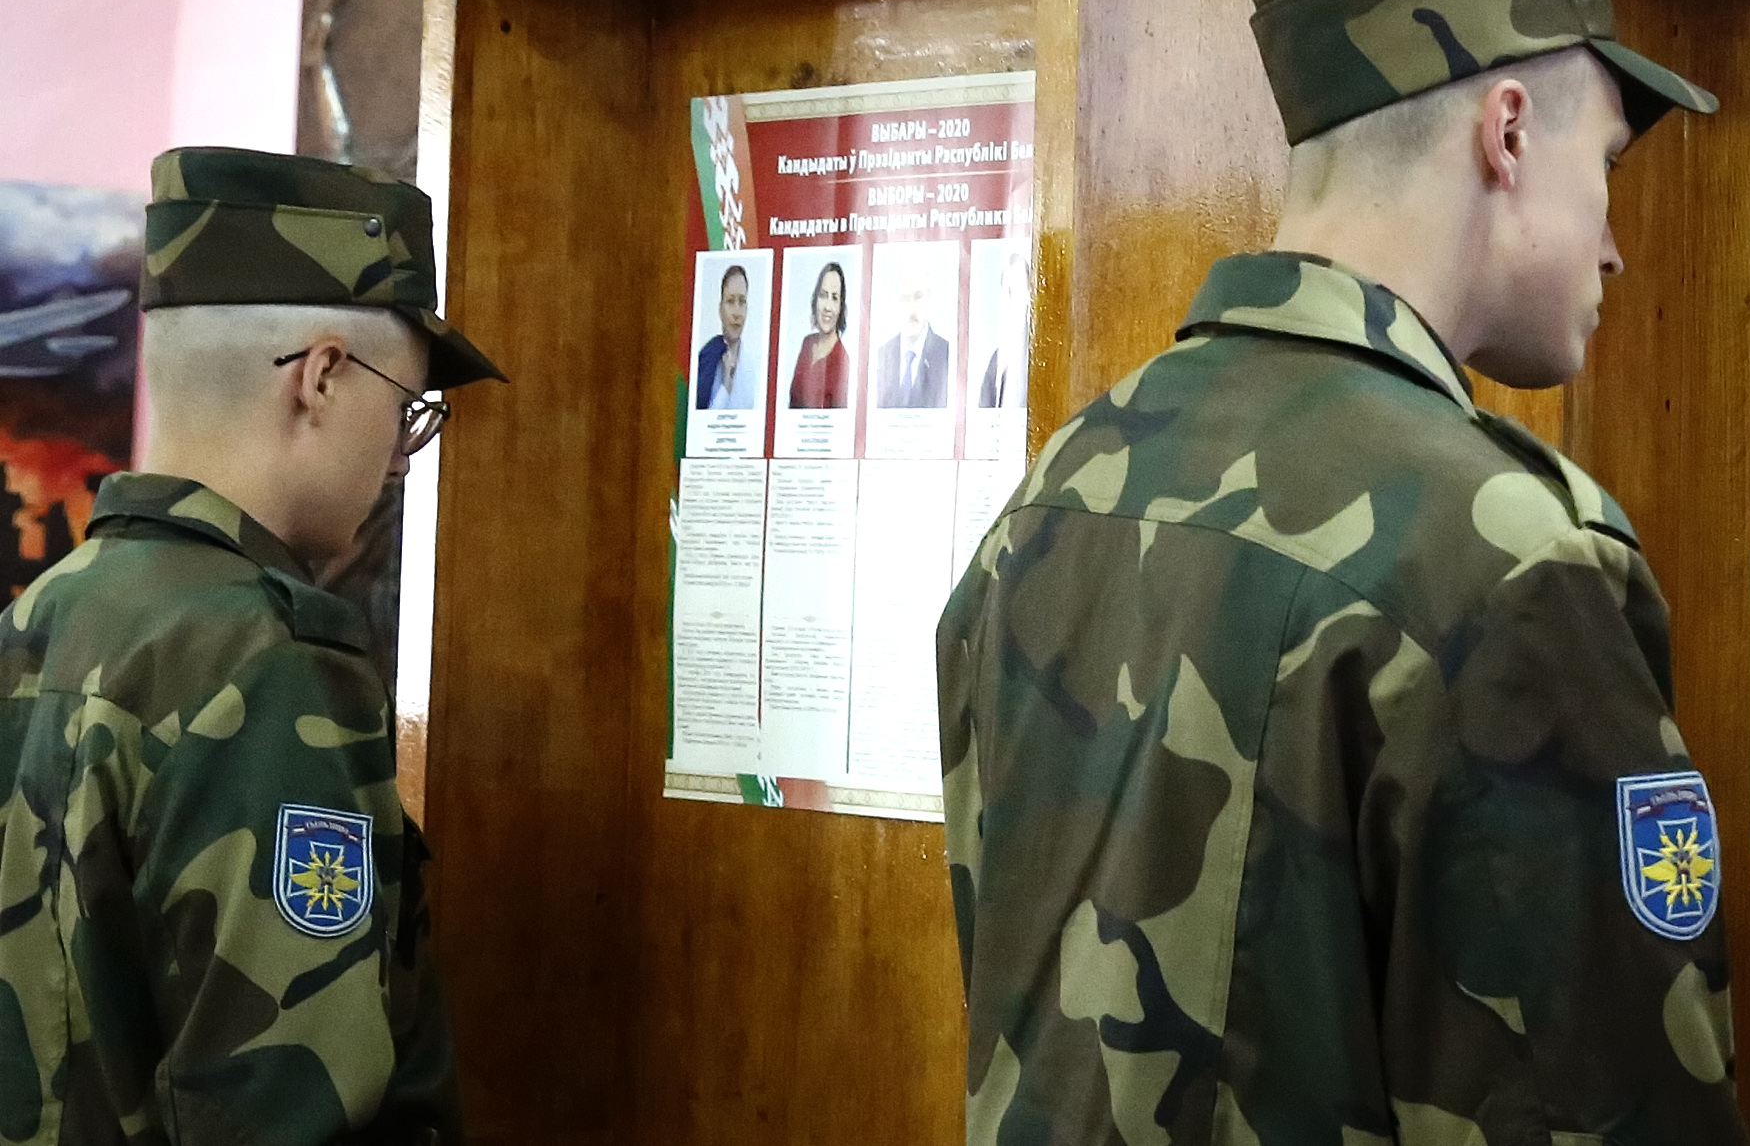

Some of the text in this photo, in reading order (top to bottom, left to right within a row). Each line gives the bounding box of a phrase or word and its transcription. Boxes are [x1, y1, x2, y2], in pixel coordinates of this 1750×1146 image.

[871, 120, 926, 142] ВЫБАРЫ
[938, 119, 971, 138] 2020
[777, 155, 848, 176] Кандыдаты
[859, 149, 932, 172] Прэзідэнты
[935, 142, 1007, 167] Рэспублікі
[937, 184, 969, 202] 2020
[769, 216, 838, 237] Кандидаты
[849, 213, 926, 236] Президенты
